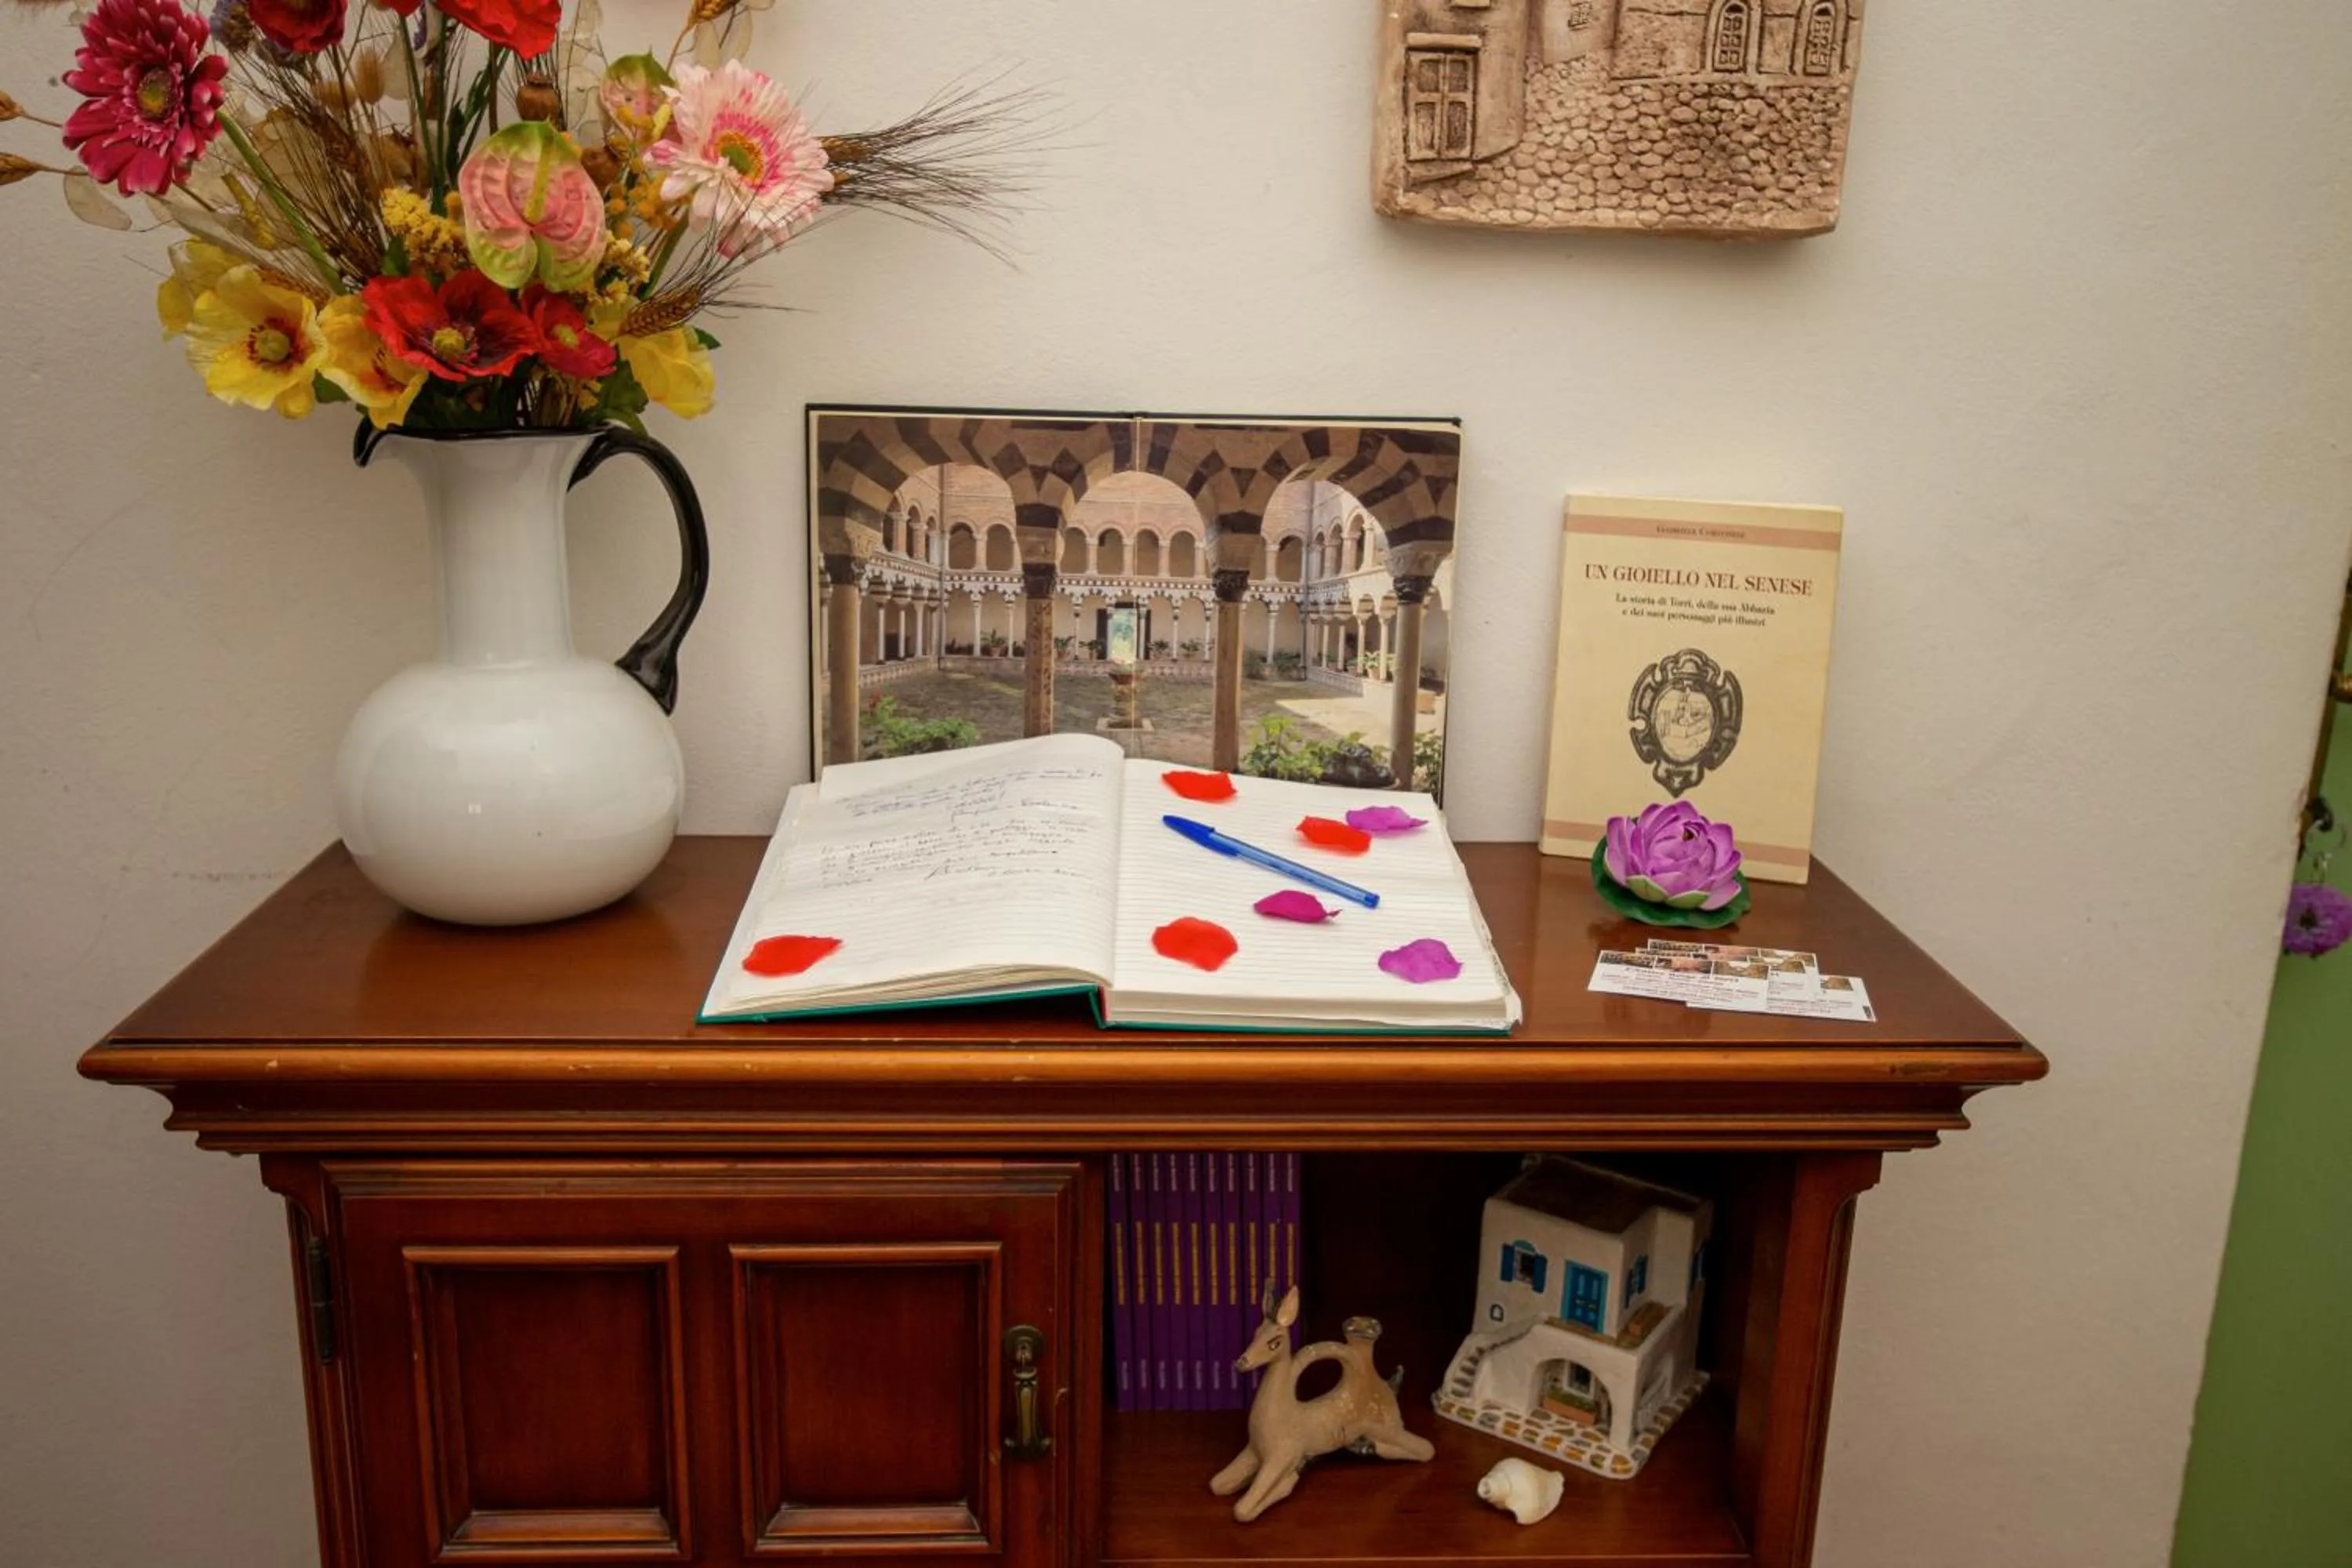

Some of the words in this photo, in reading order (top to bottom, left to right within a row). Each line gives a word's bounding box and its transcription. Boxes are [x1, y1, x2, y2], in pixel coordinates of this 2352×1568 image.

[1584, 563, 1609, 581] UN
[1613, 566, 1700, 587] GIOIELLO
[1704, 573, 1740, 590] NEL
[1744, 575, 1814, 597] SENESE
[1615, 592, 1628, 603] La
[1629, 596, 1656, 606] storia
[1657, 597, 1668, 606] di
[1696, 599, 1719, 610] della
[1629, 607, 1645, 617] dei
[1667, 612, 1716, 625] personaggi
[1734, 615, 1766, 628] illustri
